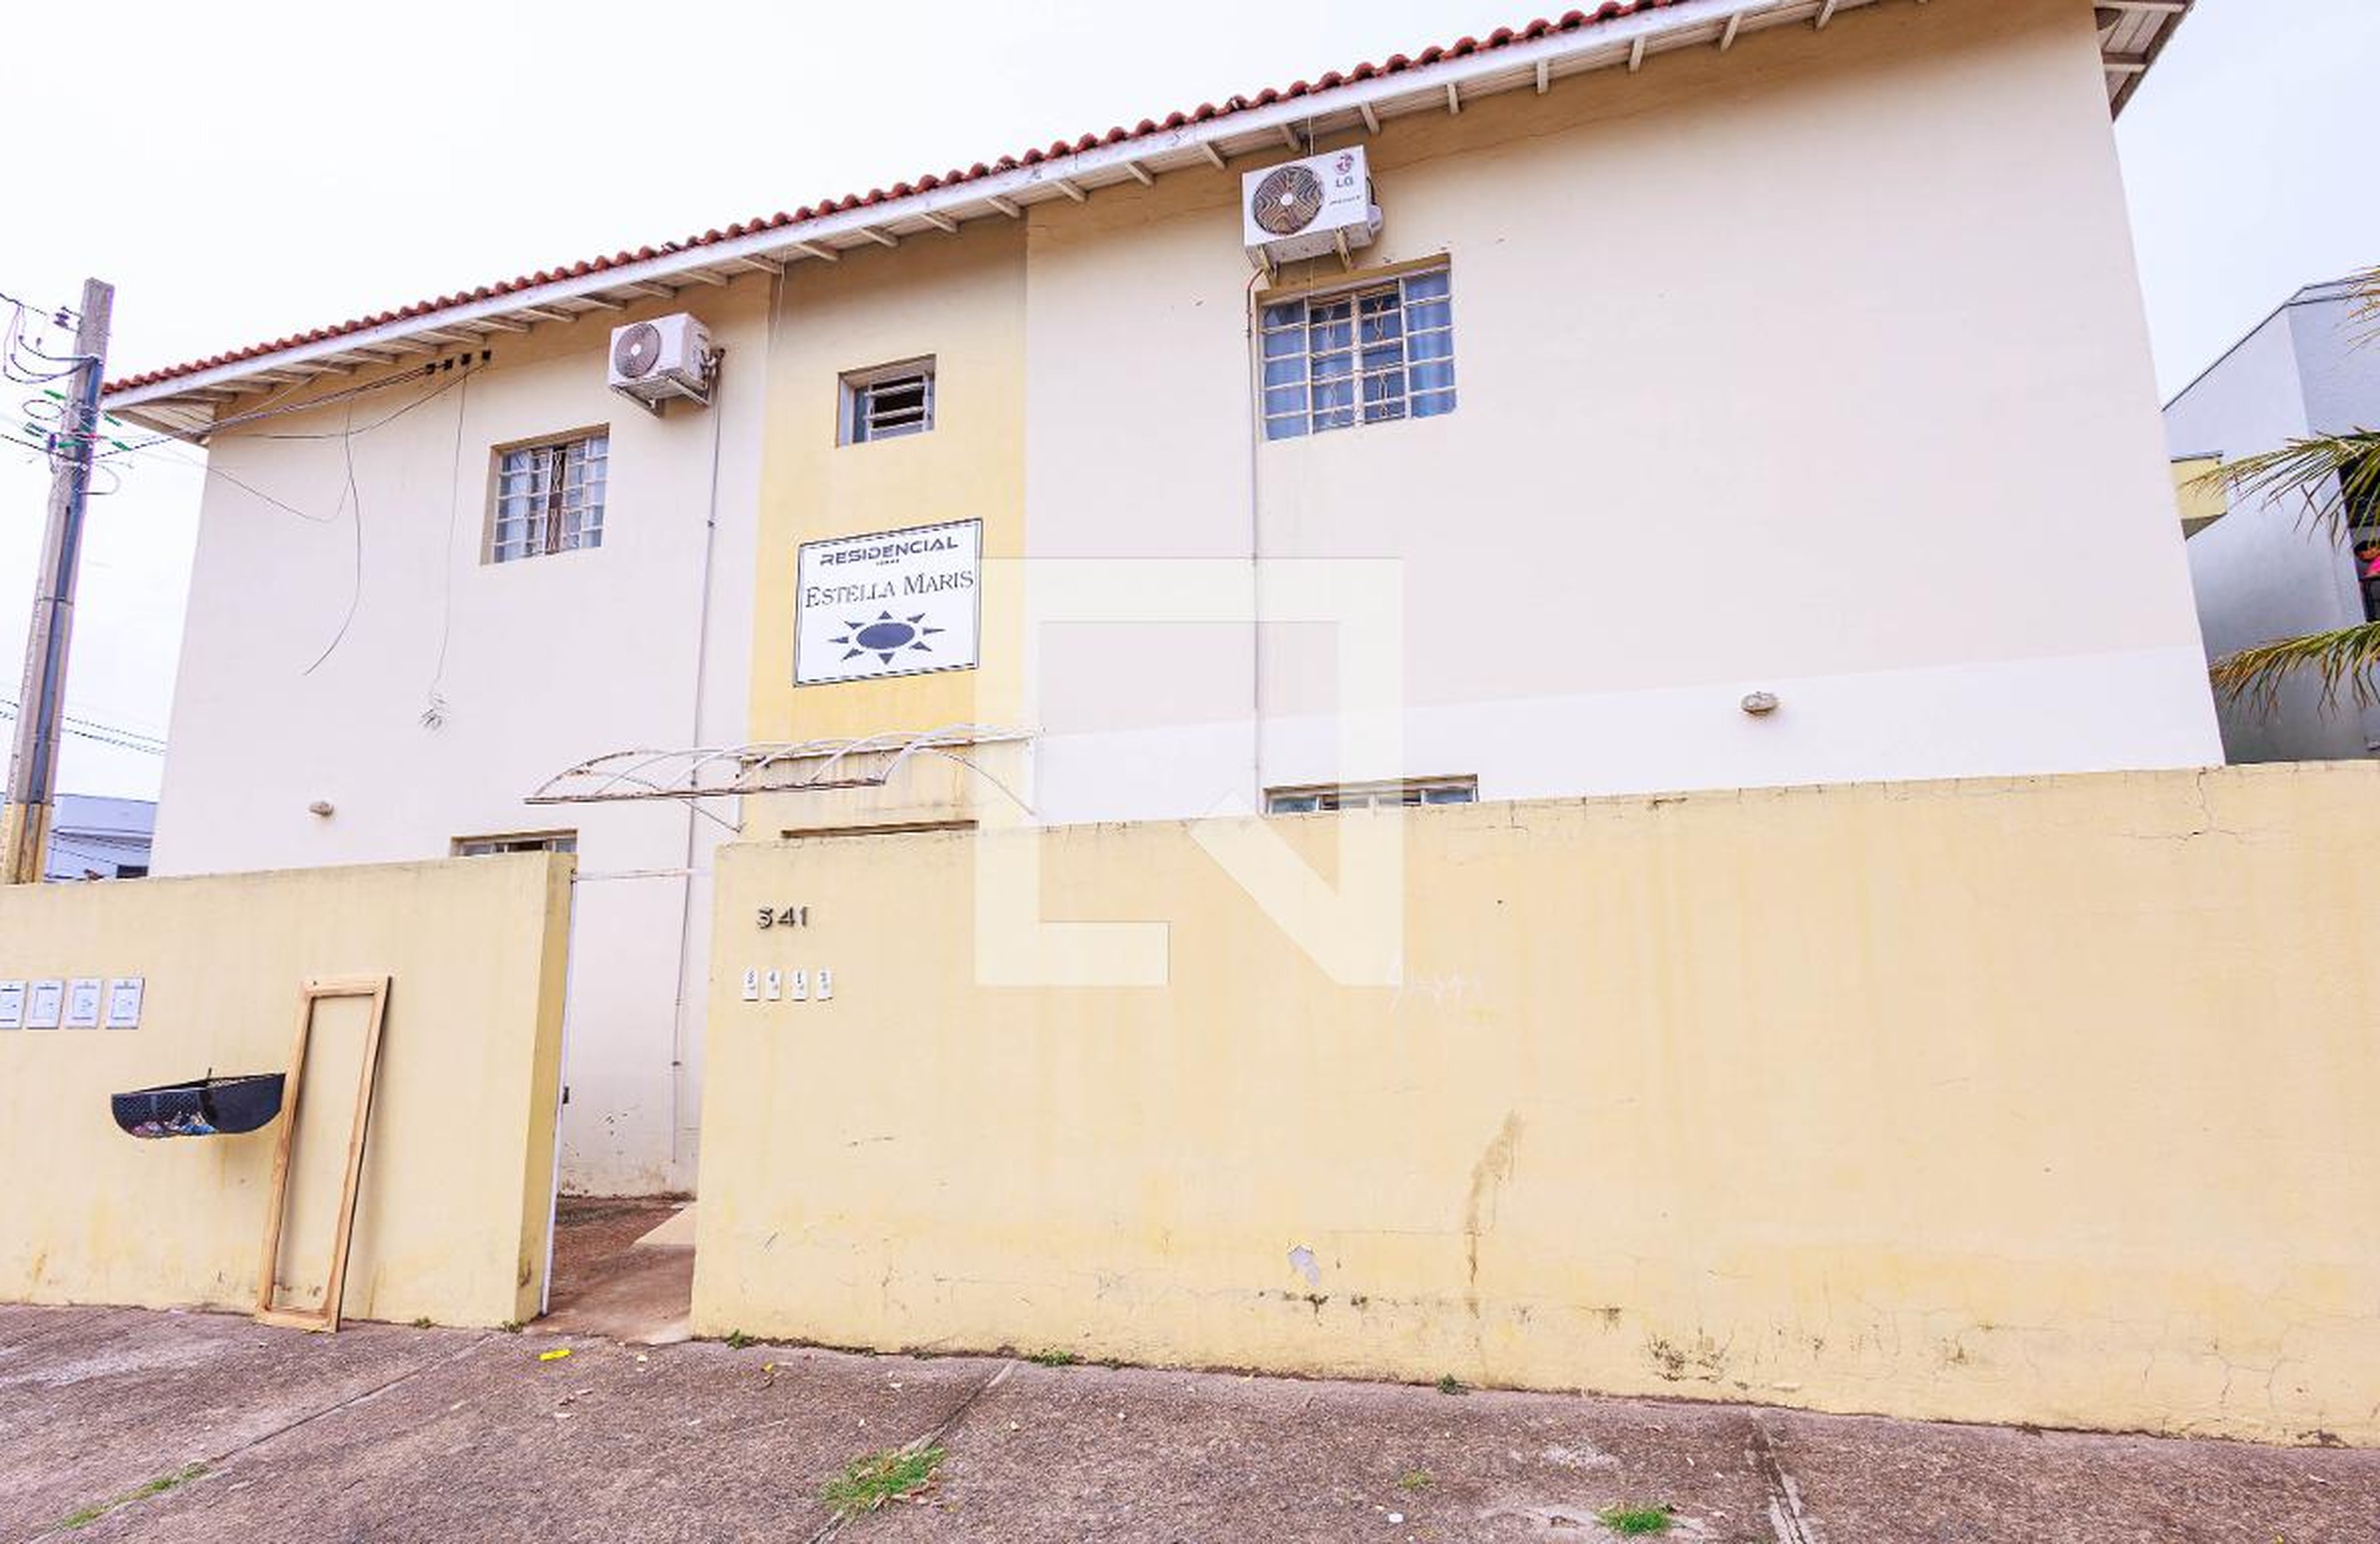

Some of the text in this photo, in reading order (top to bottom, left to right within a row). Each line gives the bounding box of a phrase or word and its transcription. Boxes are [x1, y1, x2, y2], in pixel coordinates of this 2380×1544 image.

[819, 536, 959, 566] RESIDENCIAL
[805, 570, 974, 608] ESTELLA MARIS
